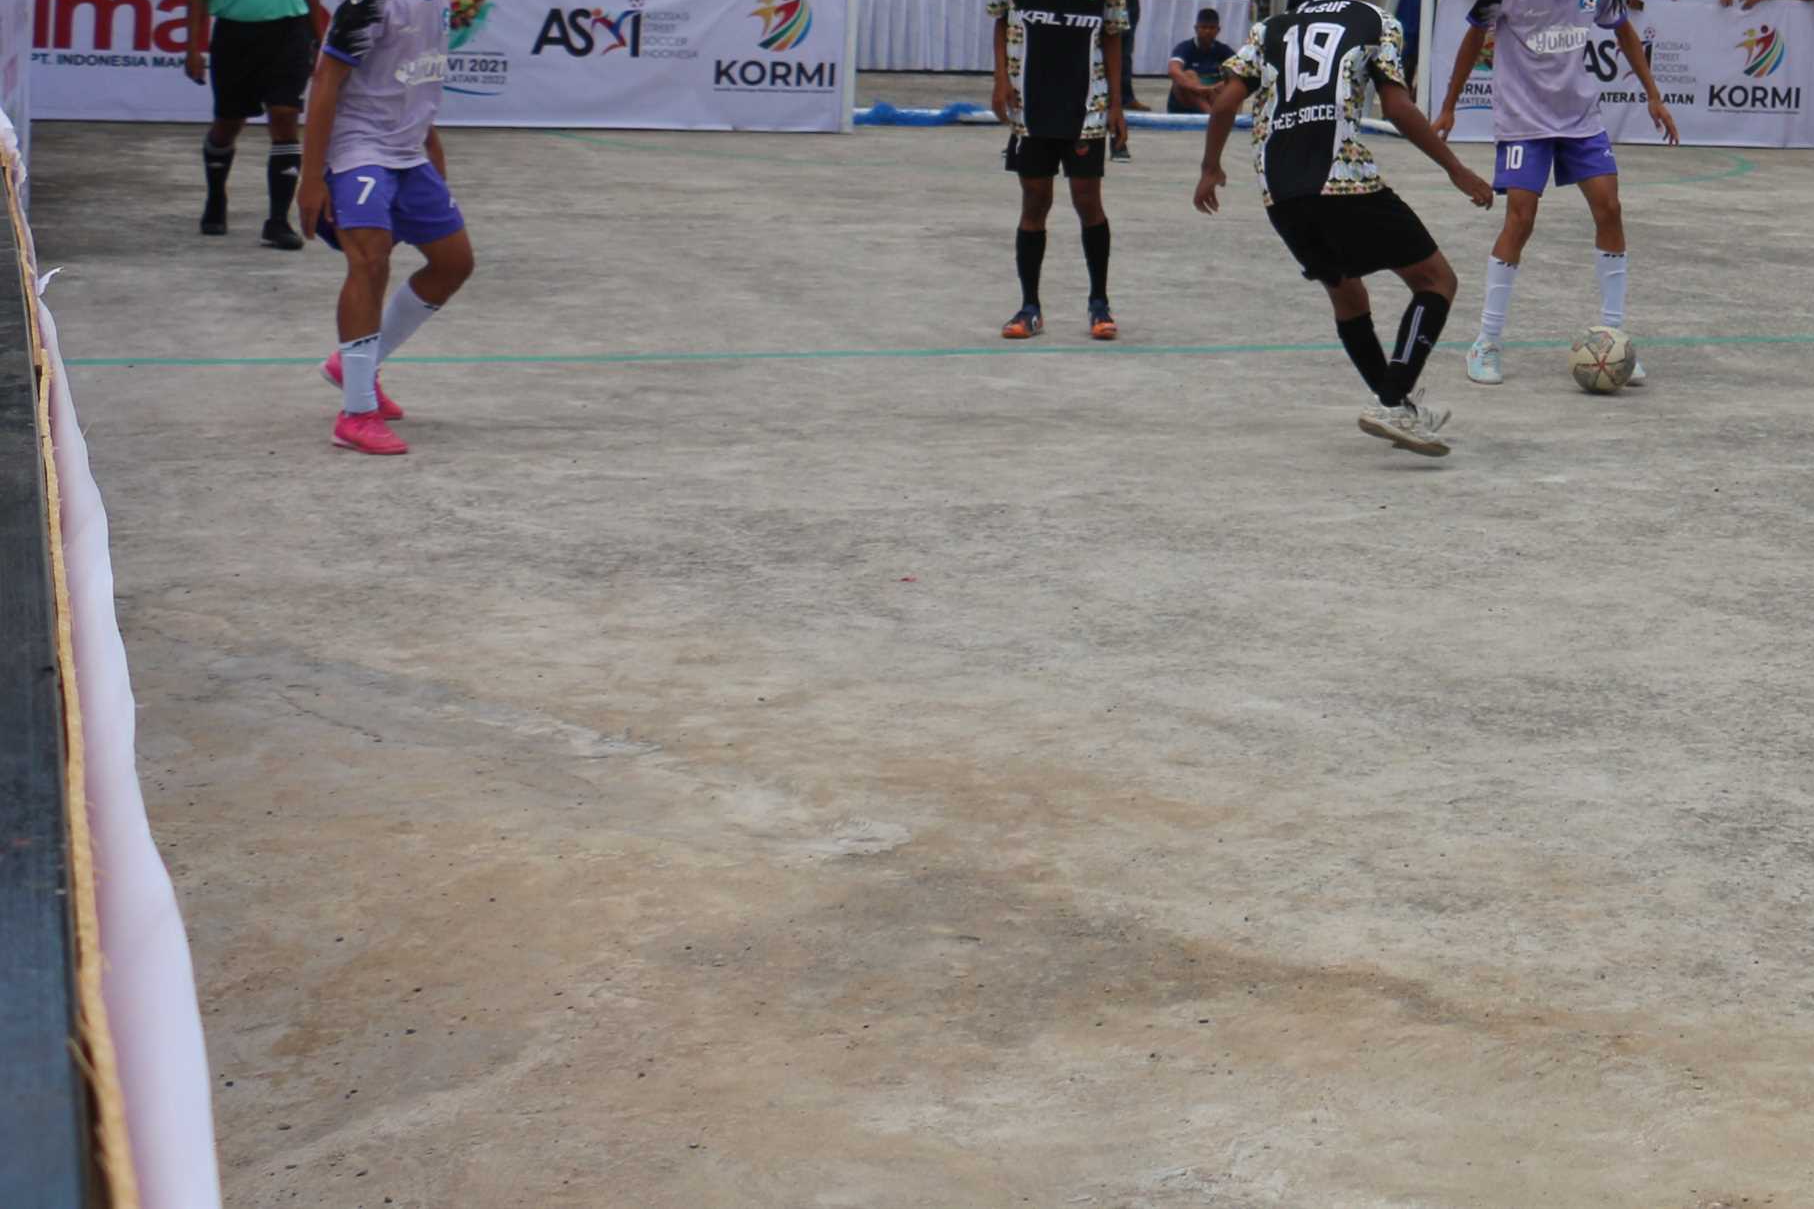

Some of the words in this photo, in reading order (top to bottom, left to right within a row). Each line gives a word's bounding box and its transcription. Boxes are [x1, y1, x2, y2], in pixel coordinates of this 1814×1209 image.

[57, 53, 147, 68] INDONESIA
[468, 59, 508, 72] 2021
[1283, 22, 1346, 103] 19
[713, 59, 836, 87] KORMI
[1600, 92, 1635, 103] ATERA
[1708, 85, 1800, 108] KORMI
[1505, 145, 1523, 170] 10
[356, 176, 377, 205] 7
